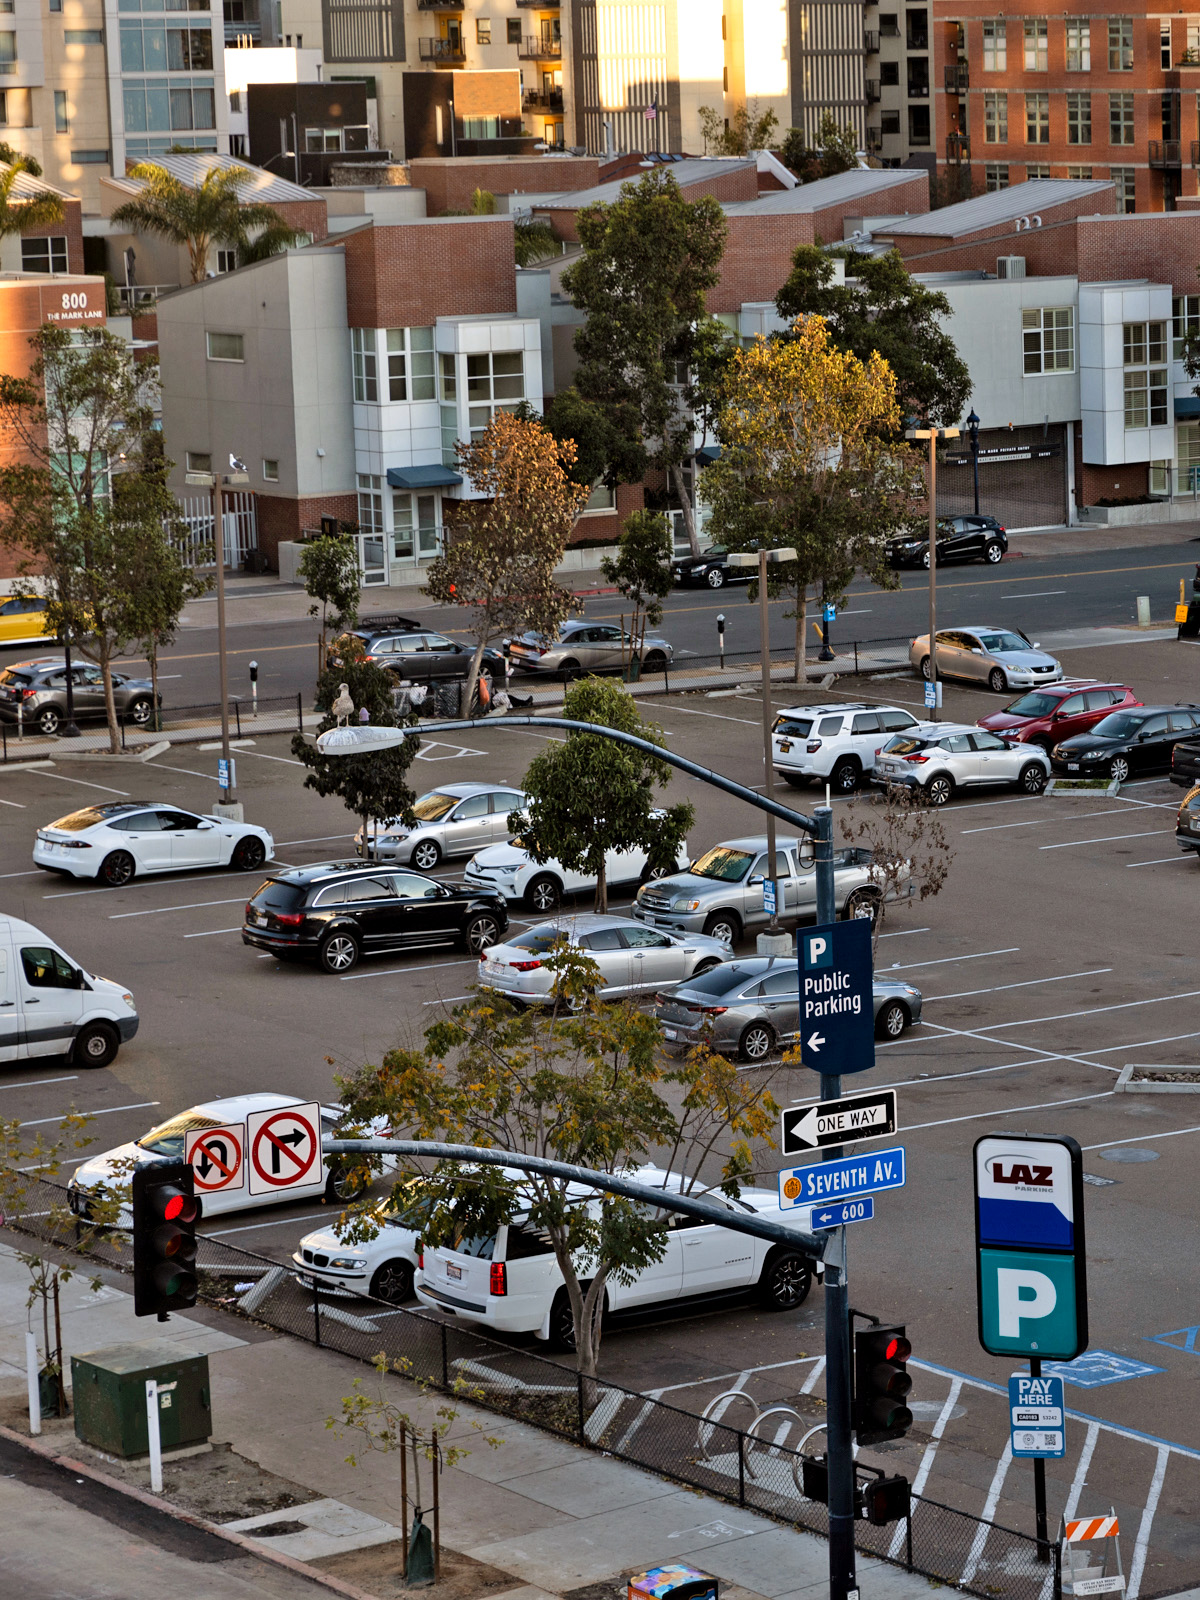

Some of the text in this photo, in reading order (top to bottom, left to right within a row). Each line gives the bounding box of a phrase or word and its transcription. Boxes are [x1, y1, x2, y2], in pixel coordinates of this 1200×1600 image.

[62, 292, 87, 309] 800
[61, 311, 83, 320] MARK
[84, 310, 102, 318] LANE
[809, 937, 827, 964] P
[804, 971, 850, 996] Public
[805, 994, 862, 1019] Parking
[817, 1108, 878, 1133] ONE WAY
[807, 1160, 897, 1196] SEVENTH AV.
[993, 1163, 1053, 1187] LAZ
[841, 1203, 865, 1220] 600
[997, 1267, 1057, 1338] P
[1018, 1379, 1053, 1394] PAY
[1018, 1394, 1053, 1405] HERE
